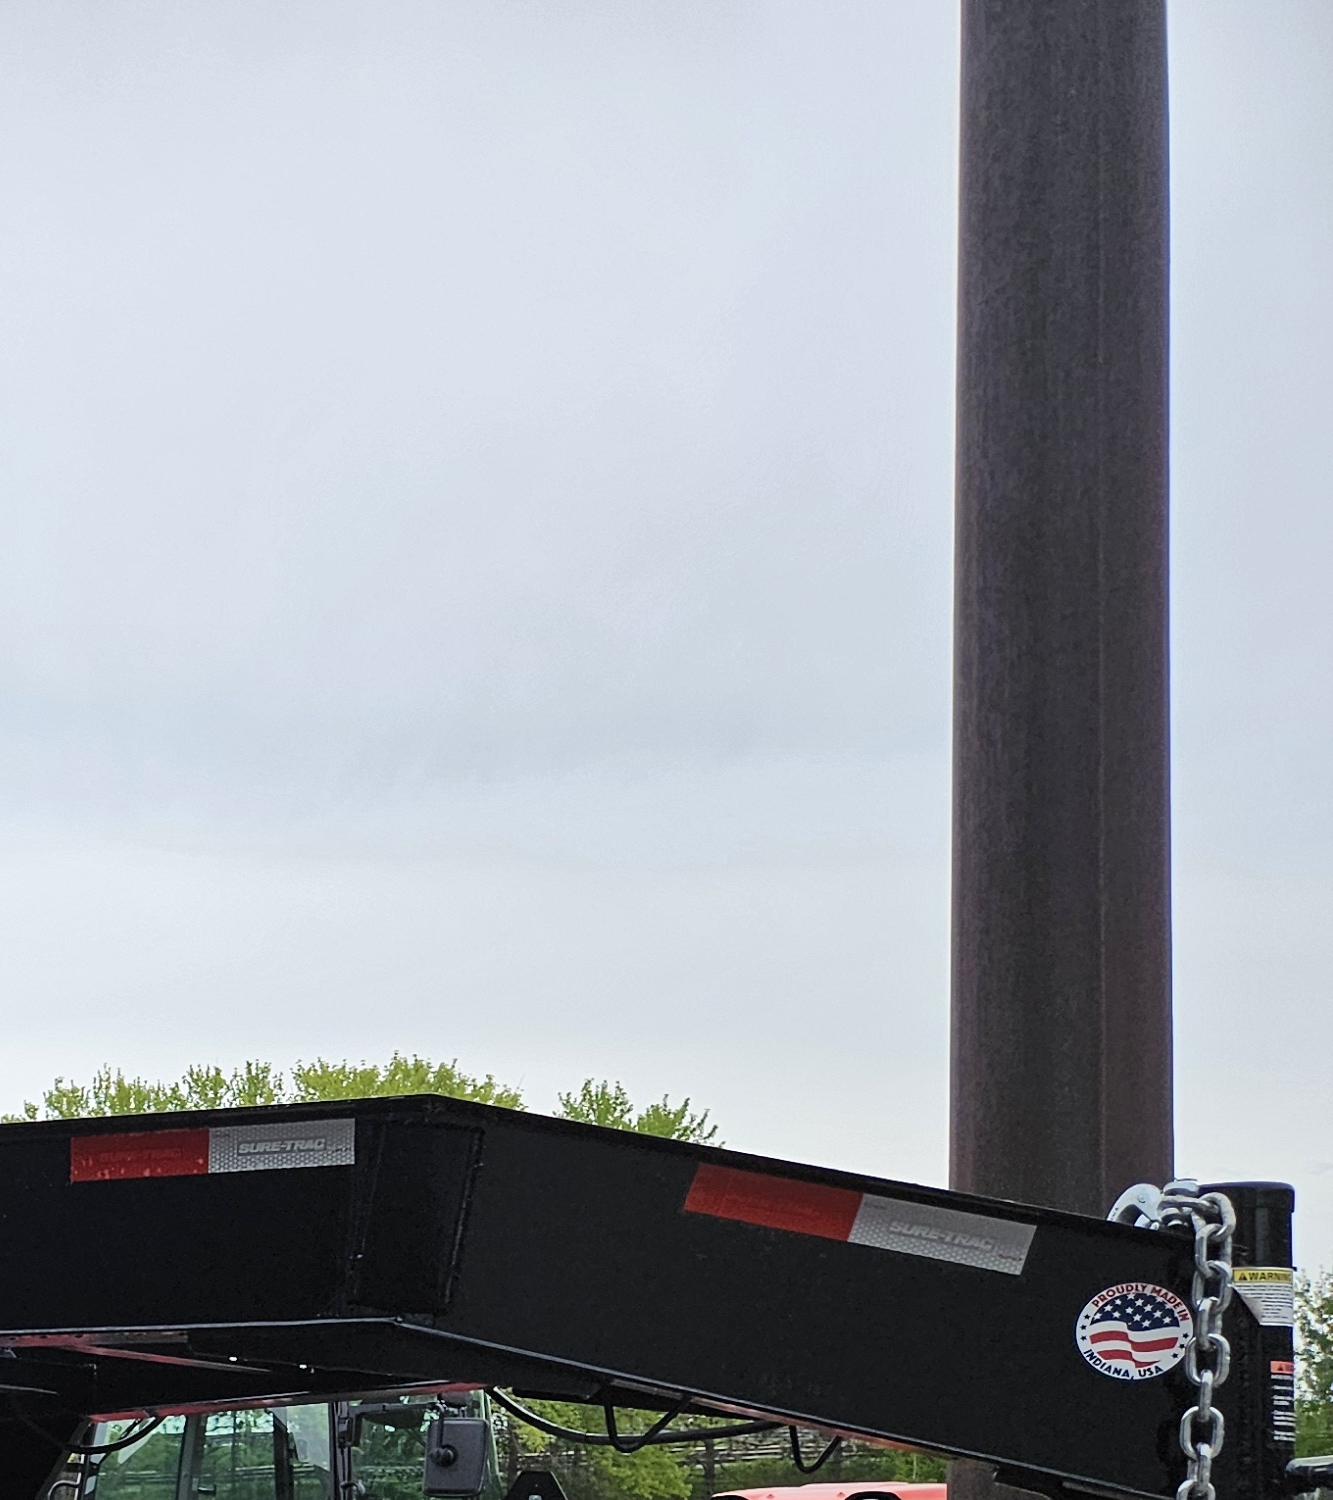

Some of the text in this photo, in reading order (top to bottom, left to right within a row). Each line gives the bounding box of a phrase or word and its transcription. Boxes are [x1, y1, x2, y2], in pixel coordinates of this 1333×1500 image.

[238, 1138, 326, 1154] SURE-TRAC
[888, 1220, 996, 1251] SURE-TRAC
[1091, 1283, 1190, 1322] PROUDLY MADE IN
[1137, 1364, 1164, 1378] USA
